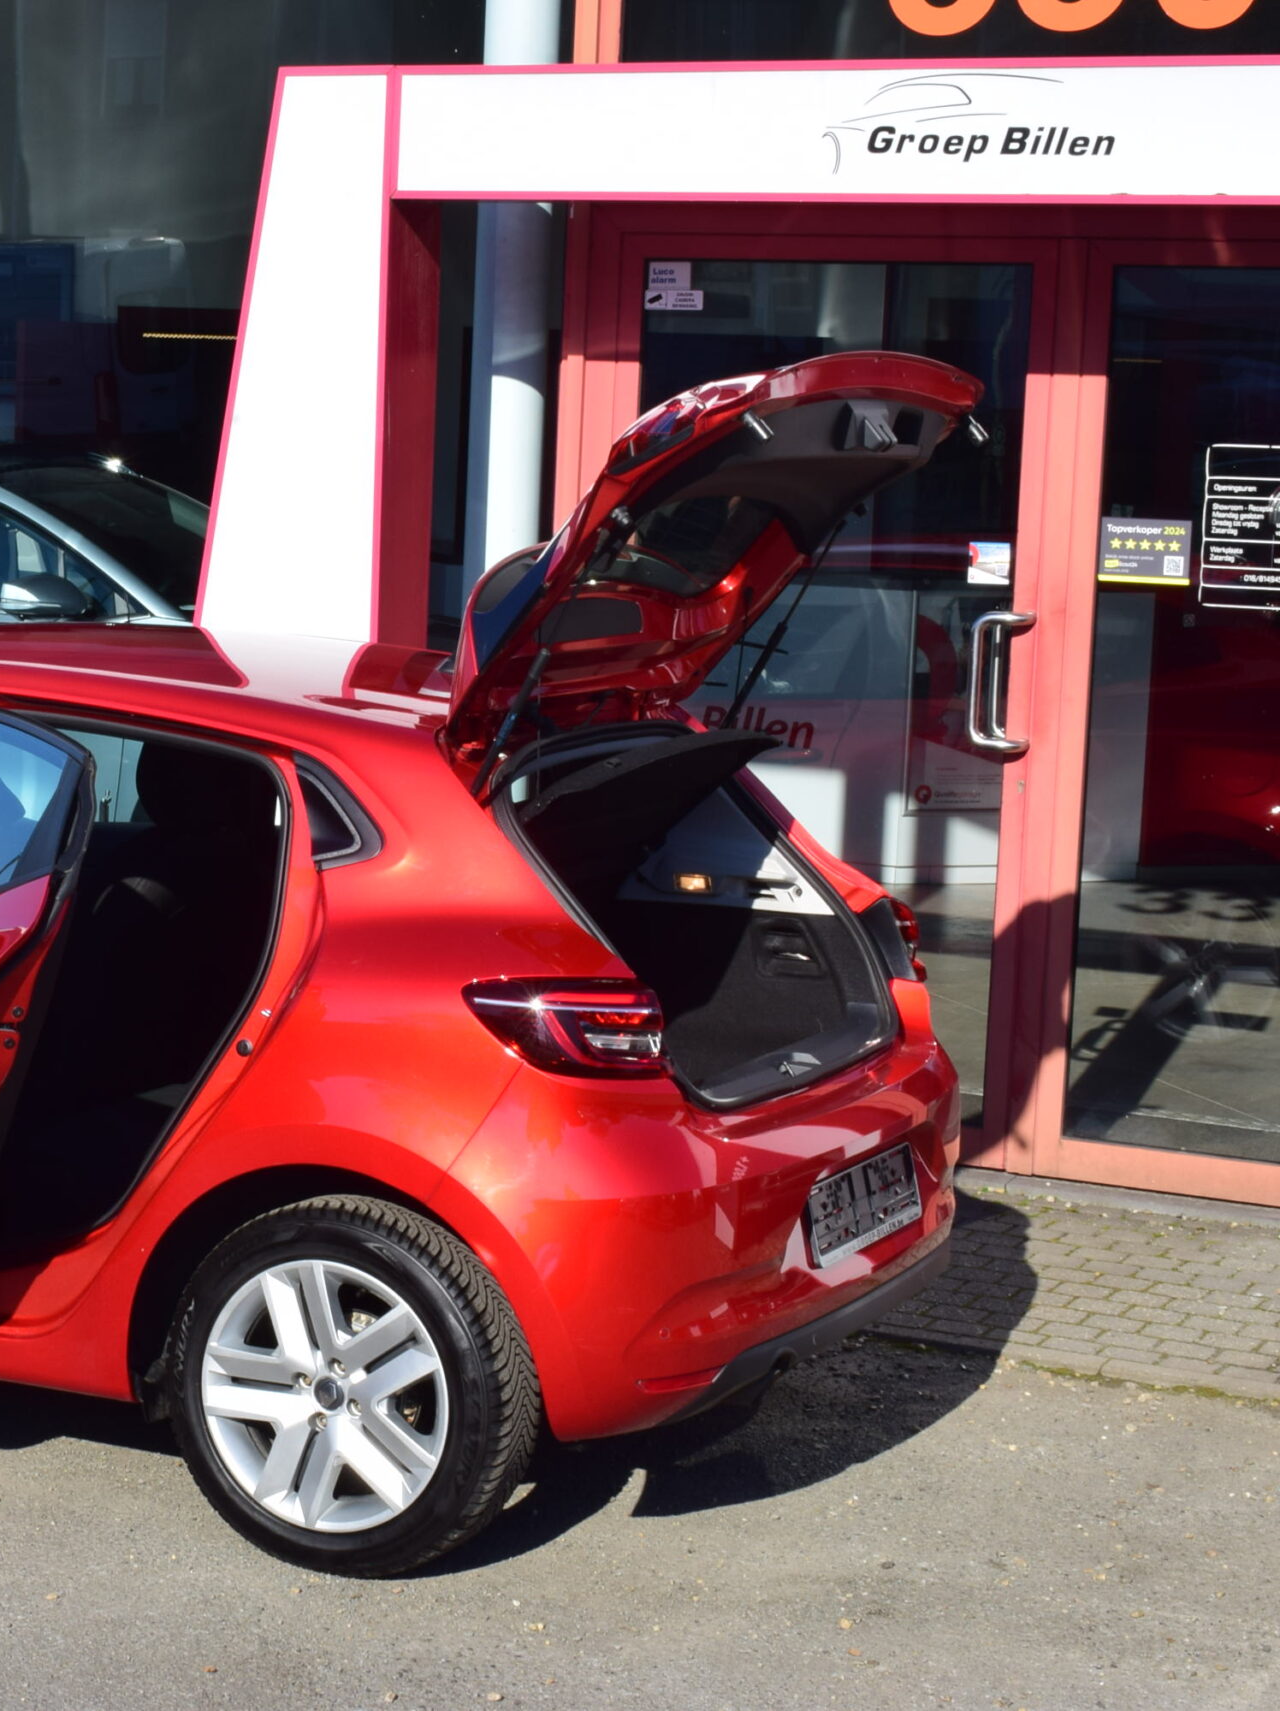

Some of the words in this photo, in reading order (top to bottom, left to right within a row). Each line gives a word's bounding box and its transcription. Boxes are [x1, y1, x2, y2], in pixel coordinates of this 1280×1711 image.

[866, 125, 990, 162] Groep
[1000, 126, 1116, 157] Billen
[651, 276, 676, 284] alarm
[1107, 523, 1162, 535] Topverkoper
[1163, 526, 1186, 536] 2024
[703, 705, 815, 749] Bllen
